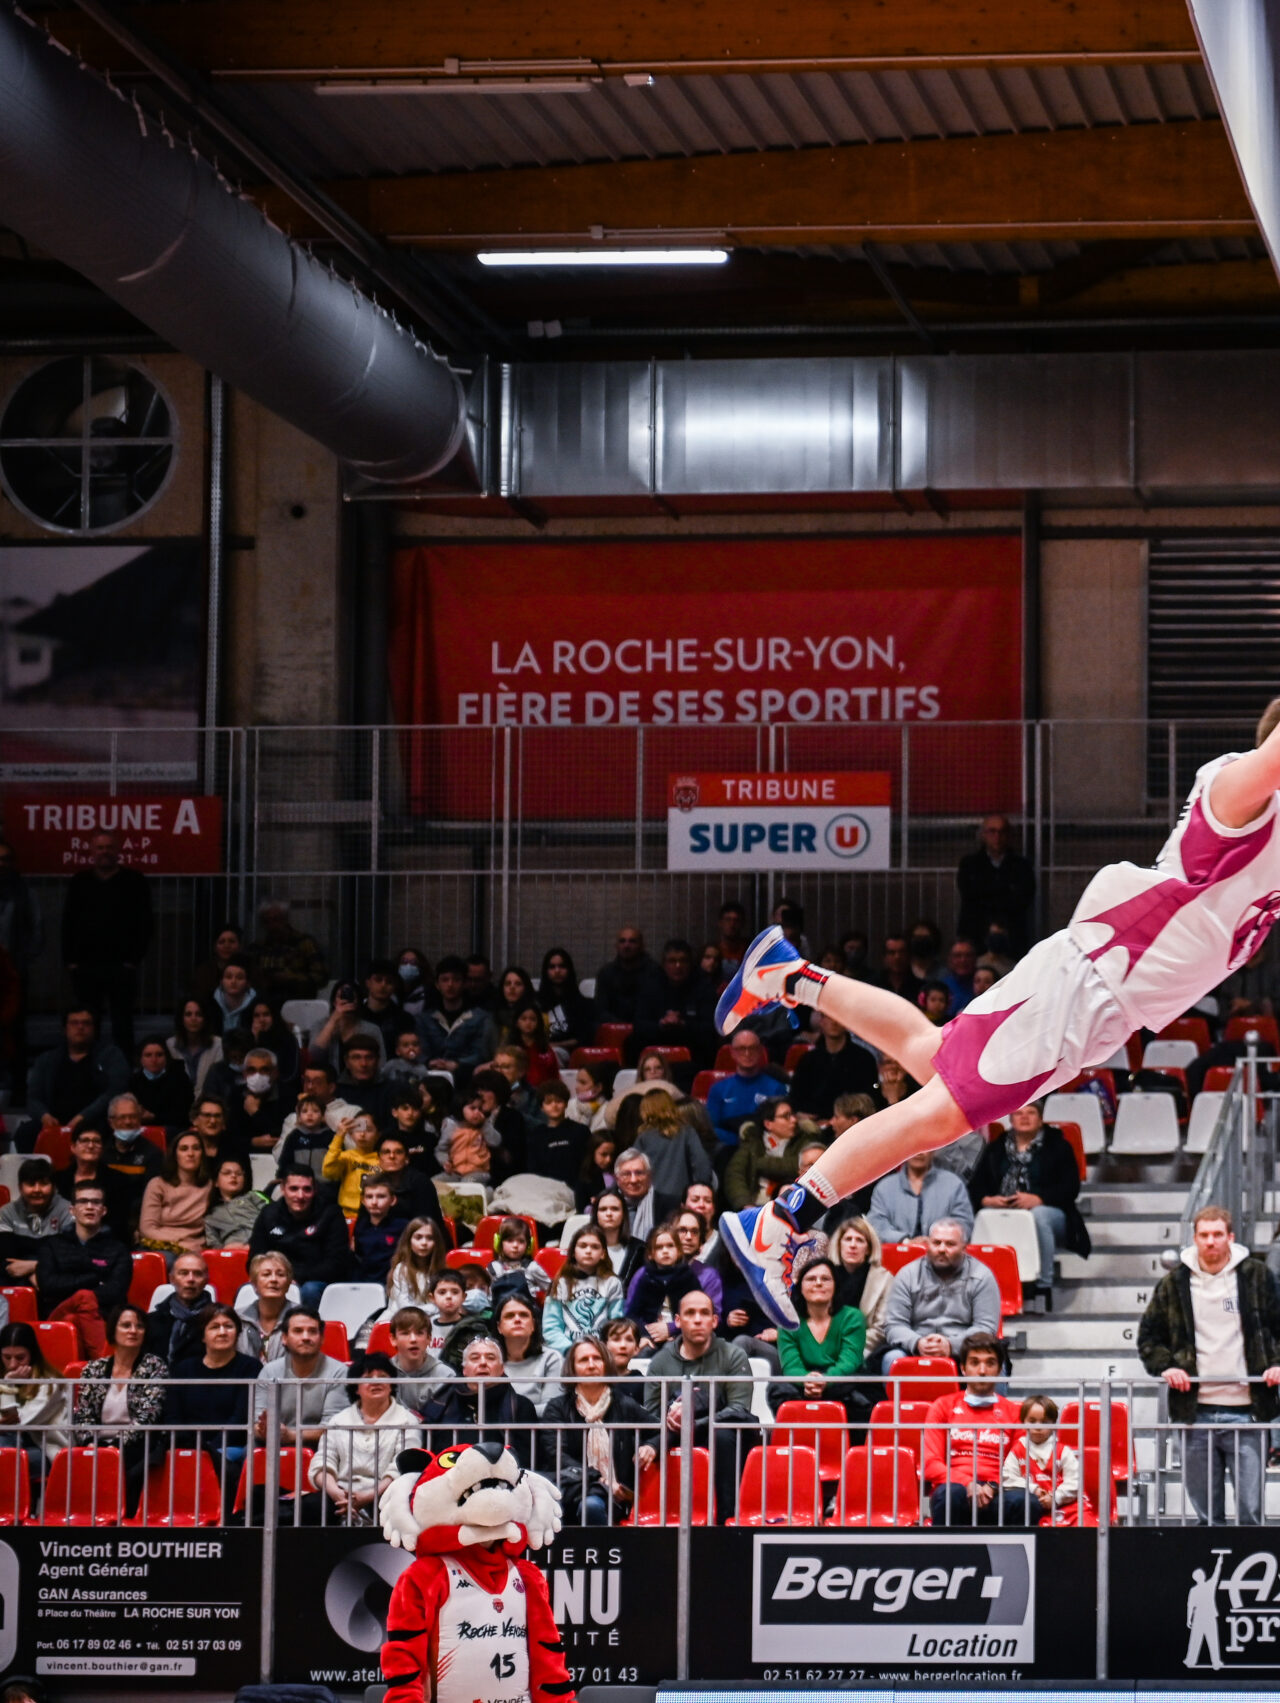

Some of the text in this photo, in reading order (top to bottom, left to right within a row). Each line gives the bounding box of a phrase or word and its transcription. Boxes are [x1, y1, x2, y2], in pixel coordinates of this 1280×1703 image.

[491, 635, 905, 675] LA ROCHE-SUR-YON,
[458, 683, 940, 725] FIÈRE DE SES SPORTIFS
[722, 779, 836, 800] TRIBUNE
[24, 799, 201, 835] TRIBUNE A
[688, 822, 817, 854] SUPER
[63, 852, 95, 865] Plac
[1136, 1293, 1147, 1303] H
[1122, 1329, 1133, 1340] G
[40, 1541, 222, 1559] Vincent BOUTHIER
[38, 1562, 148, 1579] Agent Général
[38, 1588, 147, 1600] GAN Assurances
[540, 1569, 620, 1625] NU
[45, 1609, 69, 1618] Place
[70, 1609, 82, 1618] du
[123, 1607, 139, 1618] LA
[142, 1607, 183, 1618] ROCHE
[186, 1607, 211, 1618] SUR
[214, 1607, 239, 1619] YON
[56, 1639, 69, 1650] 06
[73, 1639, 84, 1650] 17
[87, 1639, 100, 1650] 89
[103, 1639, 116, 1650] 02
[118, 1639, 131, 1650] 46
[166, 1639, 179, 1651] 02
[181, 1639, 193, 1651] 51
[197, 1639, 209, 1651] 37
[213, 1639, 225, 1651] 03
[228, 1639, 241, 1651] 09
[907, 1633, 1018, 1657] Location
[46, 1661, 183, 1673] vincent.bouthier@gan.fr
[490, 1652, 516, 1682] 15
[592, 1667, 610, 1682] 01
[618, 1667, 638, 1682] 43
